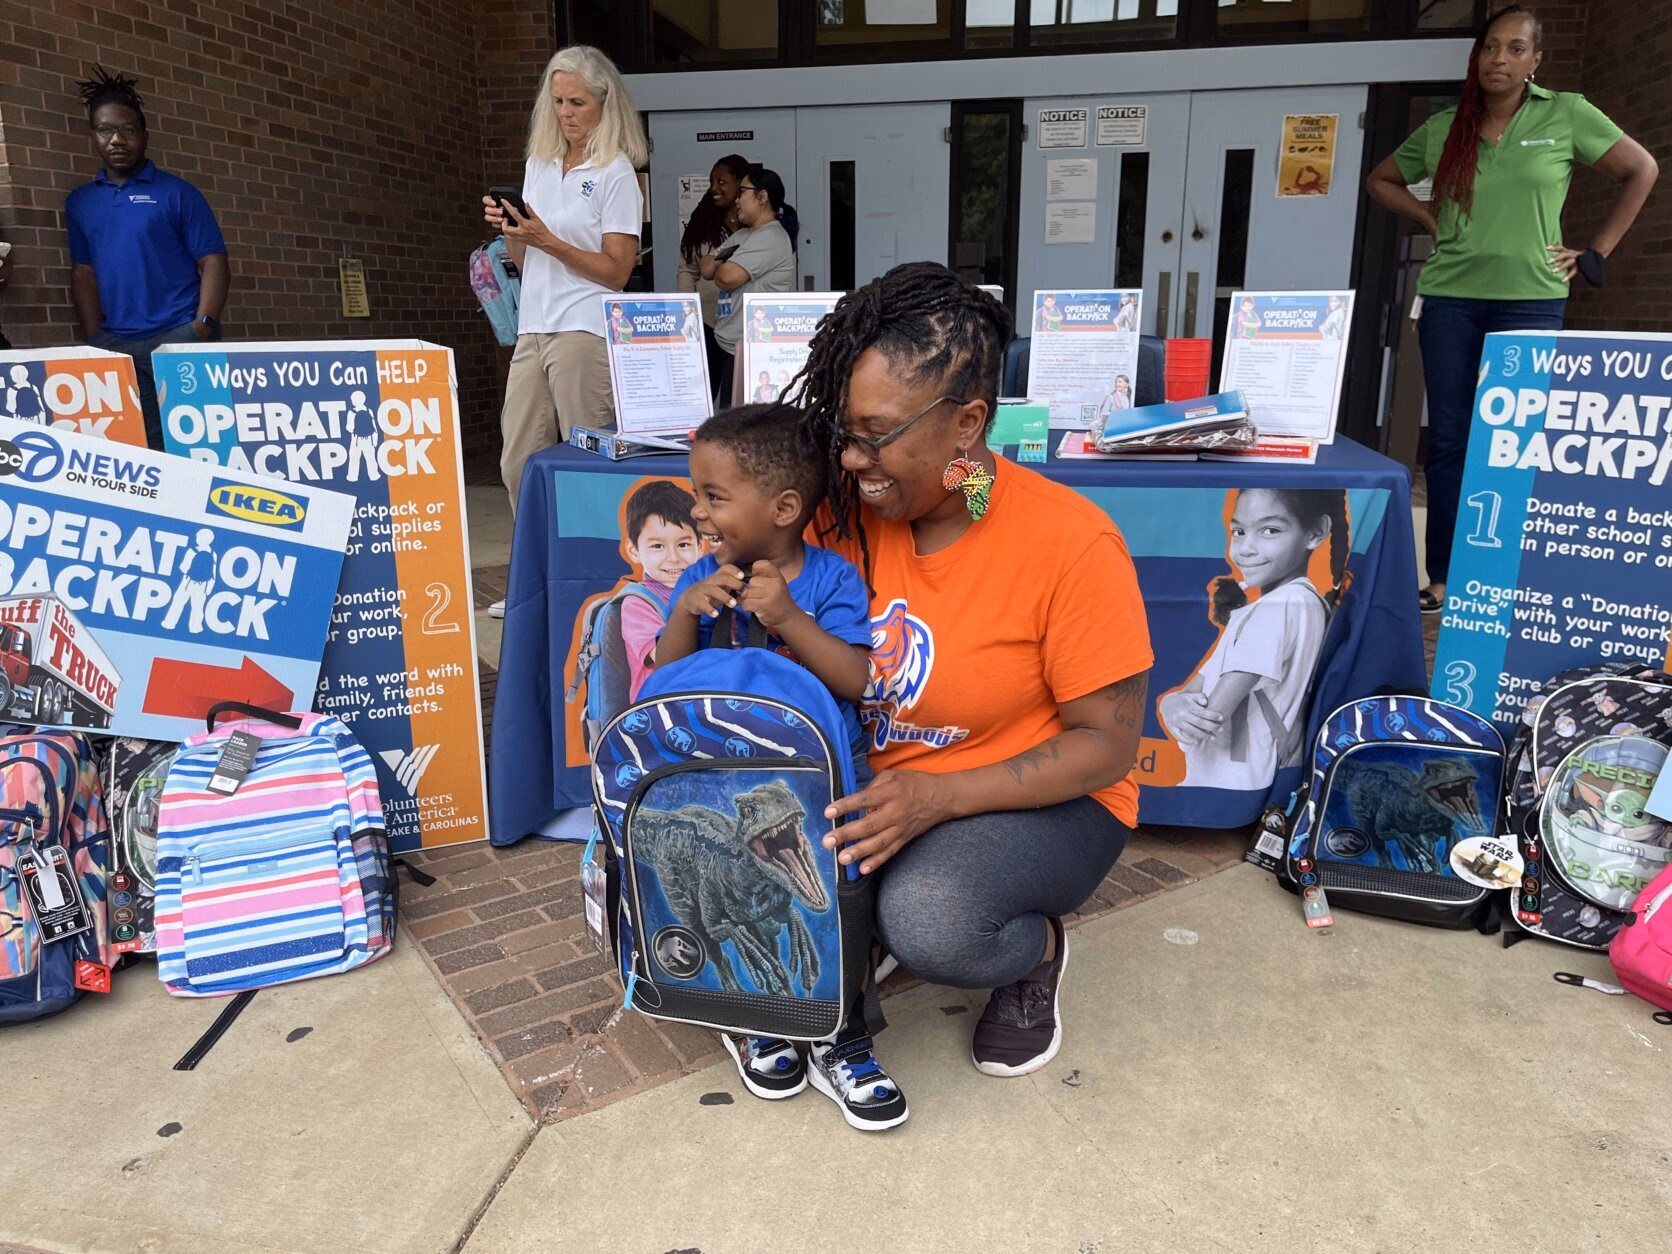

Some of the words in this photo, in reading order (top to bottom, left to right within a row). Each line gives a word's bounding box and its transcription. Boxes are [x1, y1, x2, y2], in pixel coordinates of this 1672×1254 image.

[1041, 111, 1086, 121] NOTICE
[1099, 108, 1144, 118] NOTICE
[716, 132, 752, 140] ENTRANCE
[178, 362, 197, 394] 3
[205, 362, 267, 394] Ways
[274, 361, 320, 387] YOU
[330, 361, 368, 386] Can
[376, 359, 427, 384] HELP
[1502, 345, 1521, 377] 3
[1532, 347, 1592, 382] Ways
[1602, 350, 1651, 378] YOU
[1479, 386, 1672, 438] OPERAT
[68, 449, 162, 488] NEWS
[1488, 429, 1672, 485] BACKP
[66, 471, 87, 484] ON
[90, 476, 126, 493] YOUR
[129, 484, 159, 499] SIDE
[219, 487, 301, 520] IKEA
[426, 502, 445, 516] or
[371, 518, 442, 538] supplies
[1467, 490, 1502, 548] 1
[1526, 497, 1596, 519] Donate
[1605, 509, 1617, 522] a
[1522, 517, 1580, 537] other
[1586, 525, 1652, 546] school
[371, 538, 428, 554] online.
[1520, 534, 1537, 551] in
[1545, 541, 1615, 561] person
[1623, 551, 1648, 564] or
[1466, 580, 1553, 606] Organize
[1562, 596, 1574, 609] a
[54, 602, 76, 638] the
[359, 603, 408, 622] work,
[421, 582, 461, 635] 2
[1514, 607, 1557, 625] with
[1565, 615, 1613, 633] your
[347, 625, 402, 644] group.
[1441, 615, 1511, 639] church,
[1521, 626, 1562, 644] club
[1570, 635, 1593, 649] or
[1600, 641, 1665, 664] group.
[50, 622, 117, 710] TRUCK
[338, 674, 369, 689] the
[376, 667, 418, 685] word
[427, 663, 463, 680] with
[317, 690, 375, 708] family,
[383, 682, 445, 701] friends
[1444, 660, 1476, 711] 3
[1497, 672, 1542, 692] Spre
[368, 700, 442, 720] contacts.
[1494, 690, 1527, 707] you
[382, 793, 453, 813] olunteers
[413, 825, 421, 833] &
[423, 815, 479, 832] CAROLINAS
[1480, 844, 1513, 861] WARS
[1482, 841, 1514, 858] STAR
